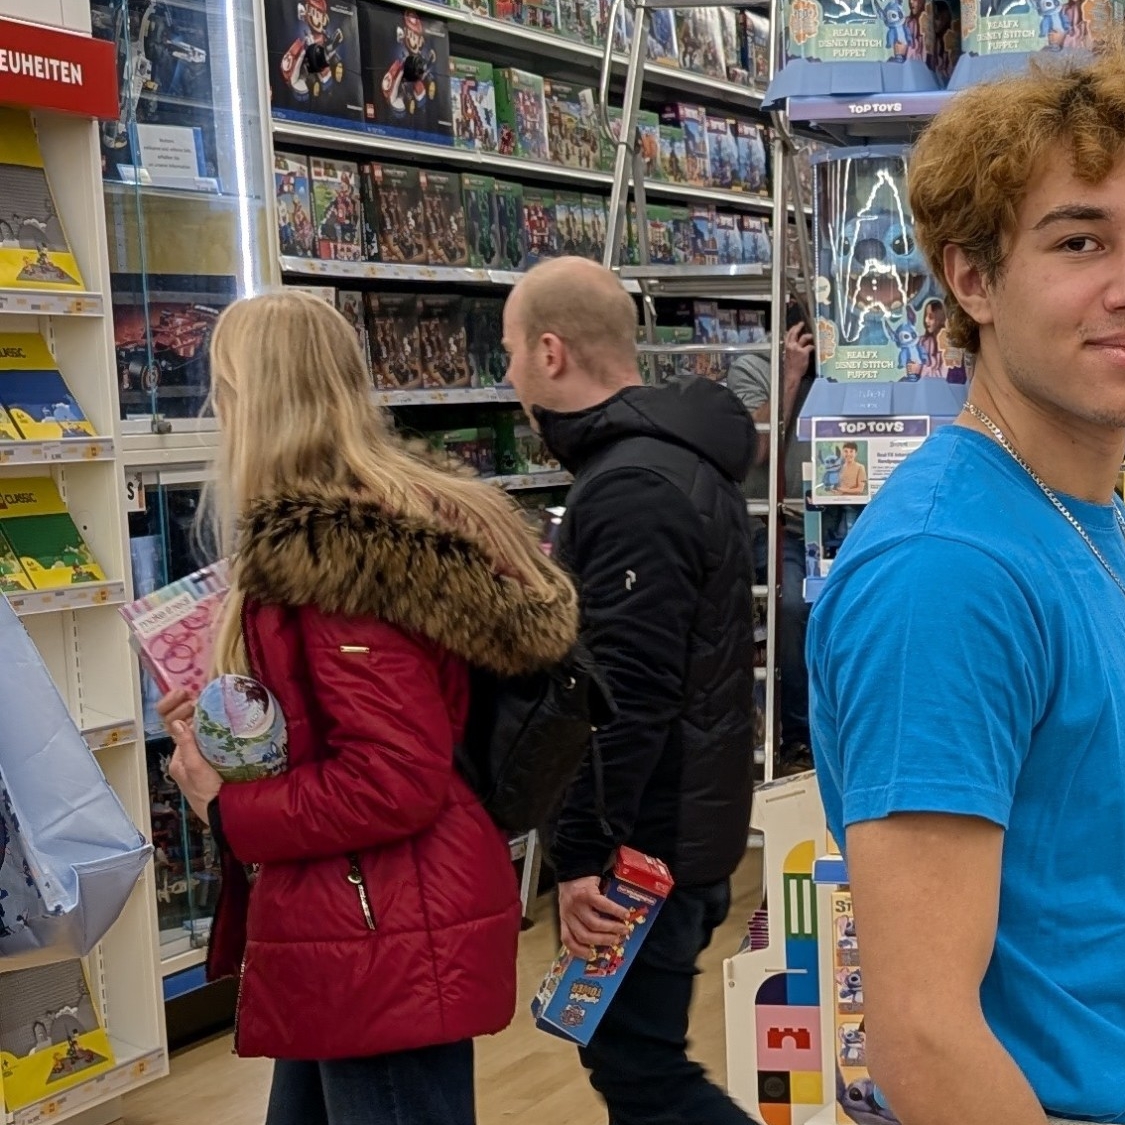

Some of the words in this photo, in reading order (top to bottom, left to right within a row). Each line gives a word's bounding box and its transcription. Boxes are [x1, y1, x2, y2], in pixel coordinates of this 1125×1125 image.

[1003, 30, 1035, 38] STITCH
[850, 38, 882, 47] STITCH
[833, 49, 866, 57] PUPPET
[848, 104, 872, 114] TOP
[872, 102, 902, 112] TOYS
[862, 360, 894, 369] STITCH
[838, 422, 866, 433] TOP
[867, 421, 904, 432] TOYS
